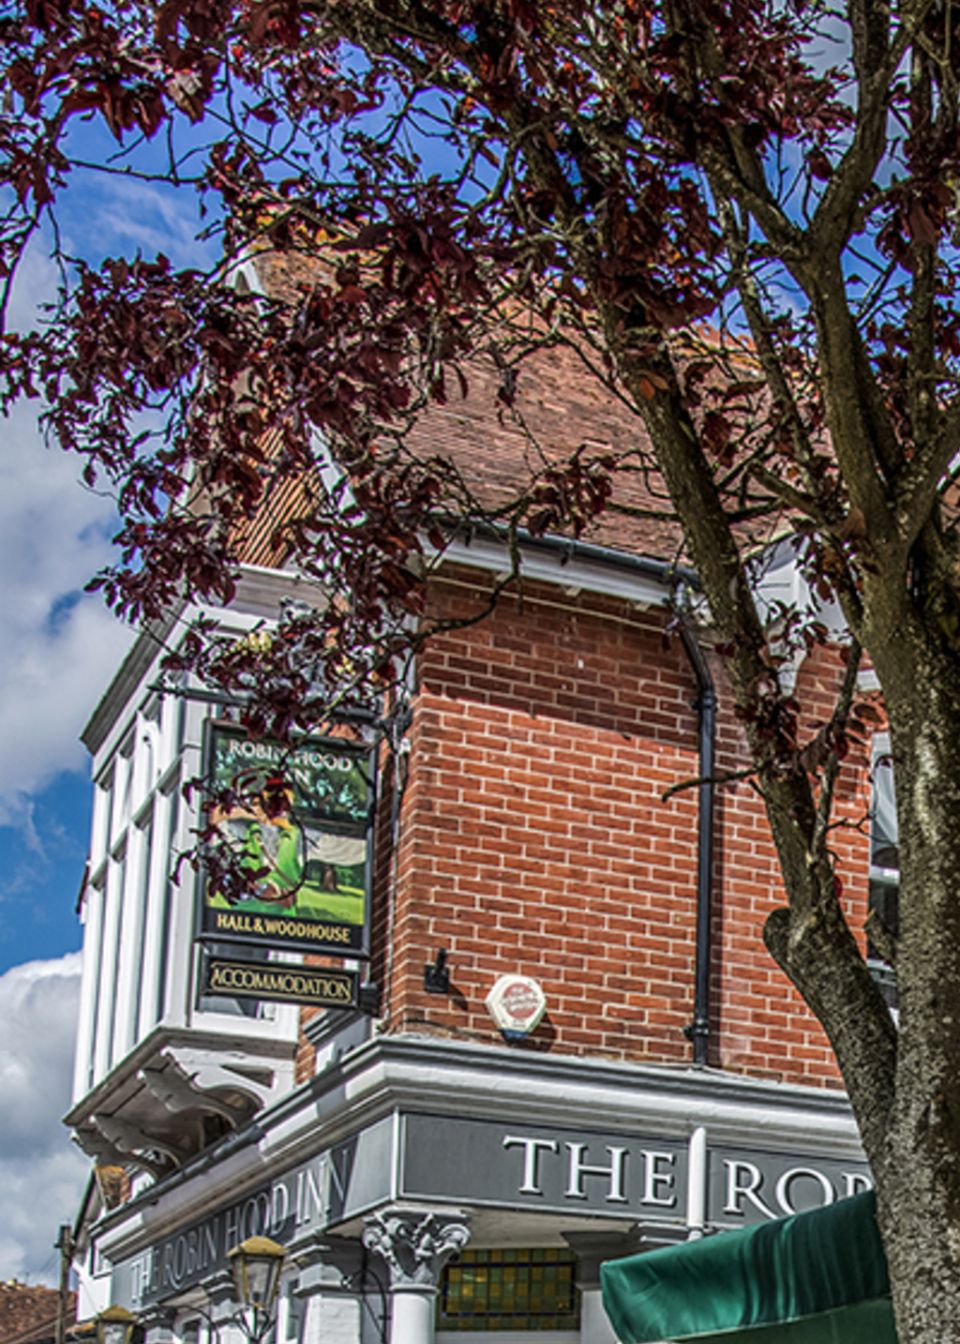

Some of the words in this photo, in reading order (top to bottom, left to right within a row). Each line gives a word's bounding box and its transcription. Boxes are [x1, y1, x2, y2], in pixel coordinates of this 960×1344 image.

[212, 967, 350, 998] ACCOMMODATION
[502, 1134, 678, 1207] THE
[162, 1215, 220, 1290] ROBIN
[224, 1183, 290, 1252] HOOD
[296, 1149, 349, 1226] INN
